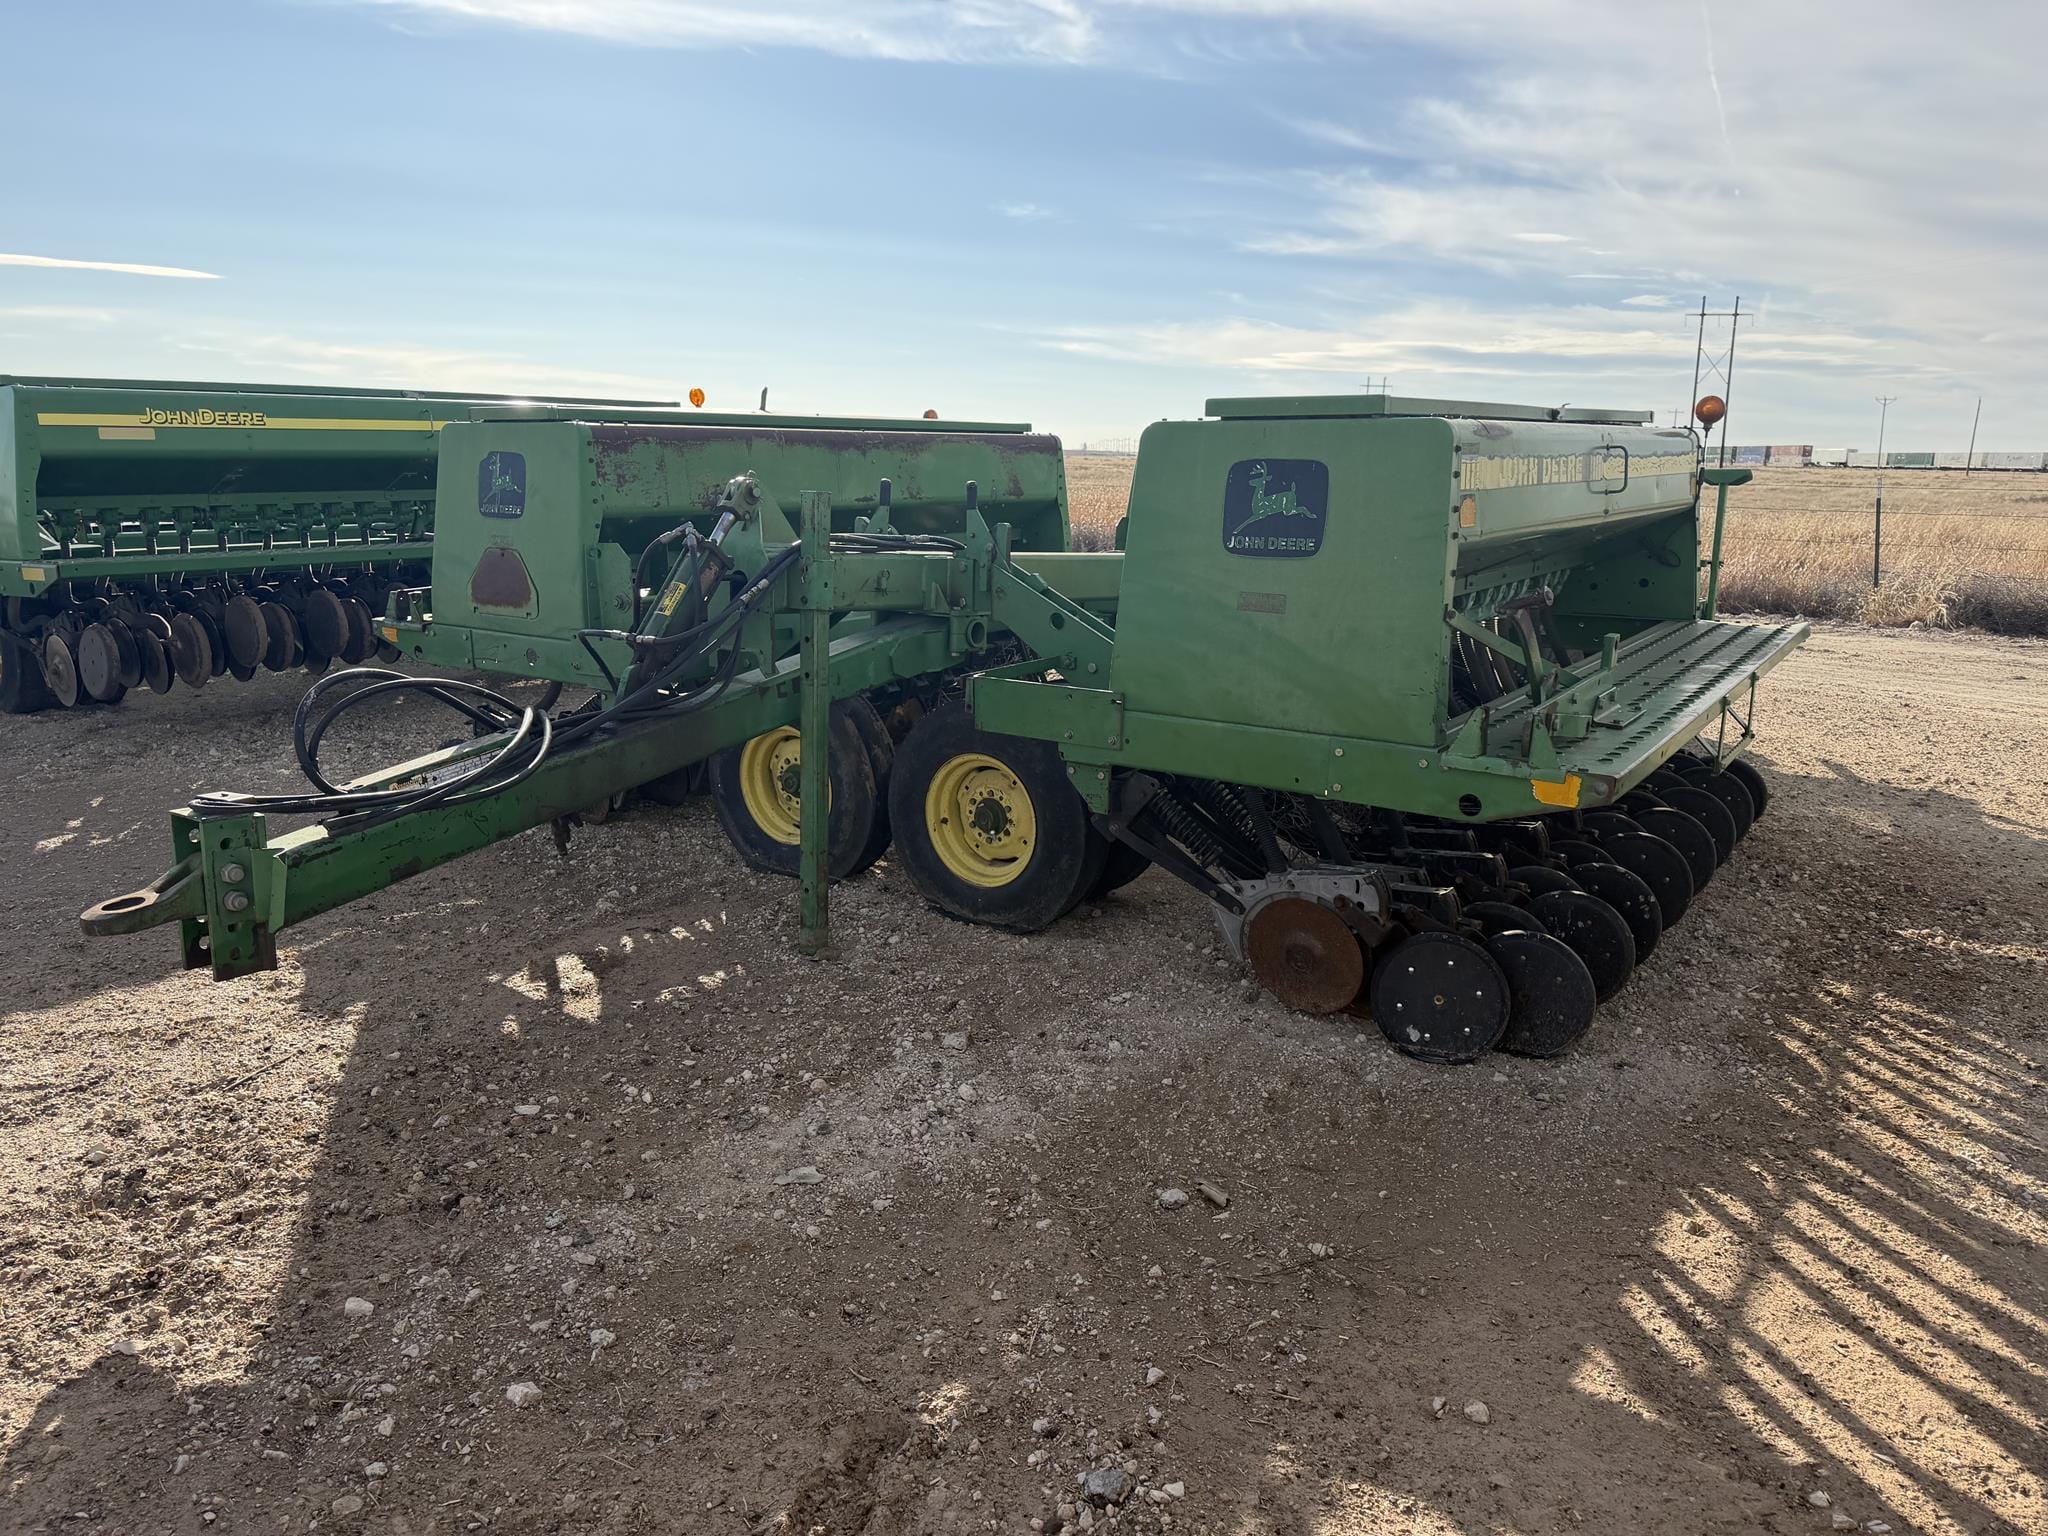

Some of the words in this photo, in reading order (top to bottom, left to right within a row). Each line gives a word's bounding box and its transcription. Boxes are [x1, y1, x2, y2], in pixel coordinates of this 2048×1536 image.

[139, 407, 199, 425] JOHN
[198, 409, 266, 425] DEERE
[1542, 456, 1584, 483] DEERE
[1226, 535, 1265, 549] JOHN
[1267, 537, 1315, 551] DEERE
